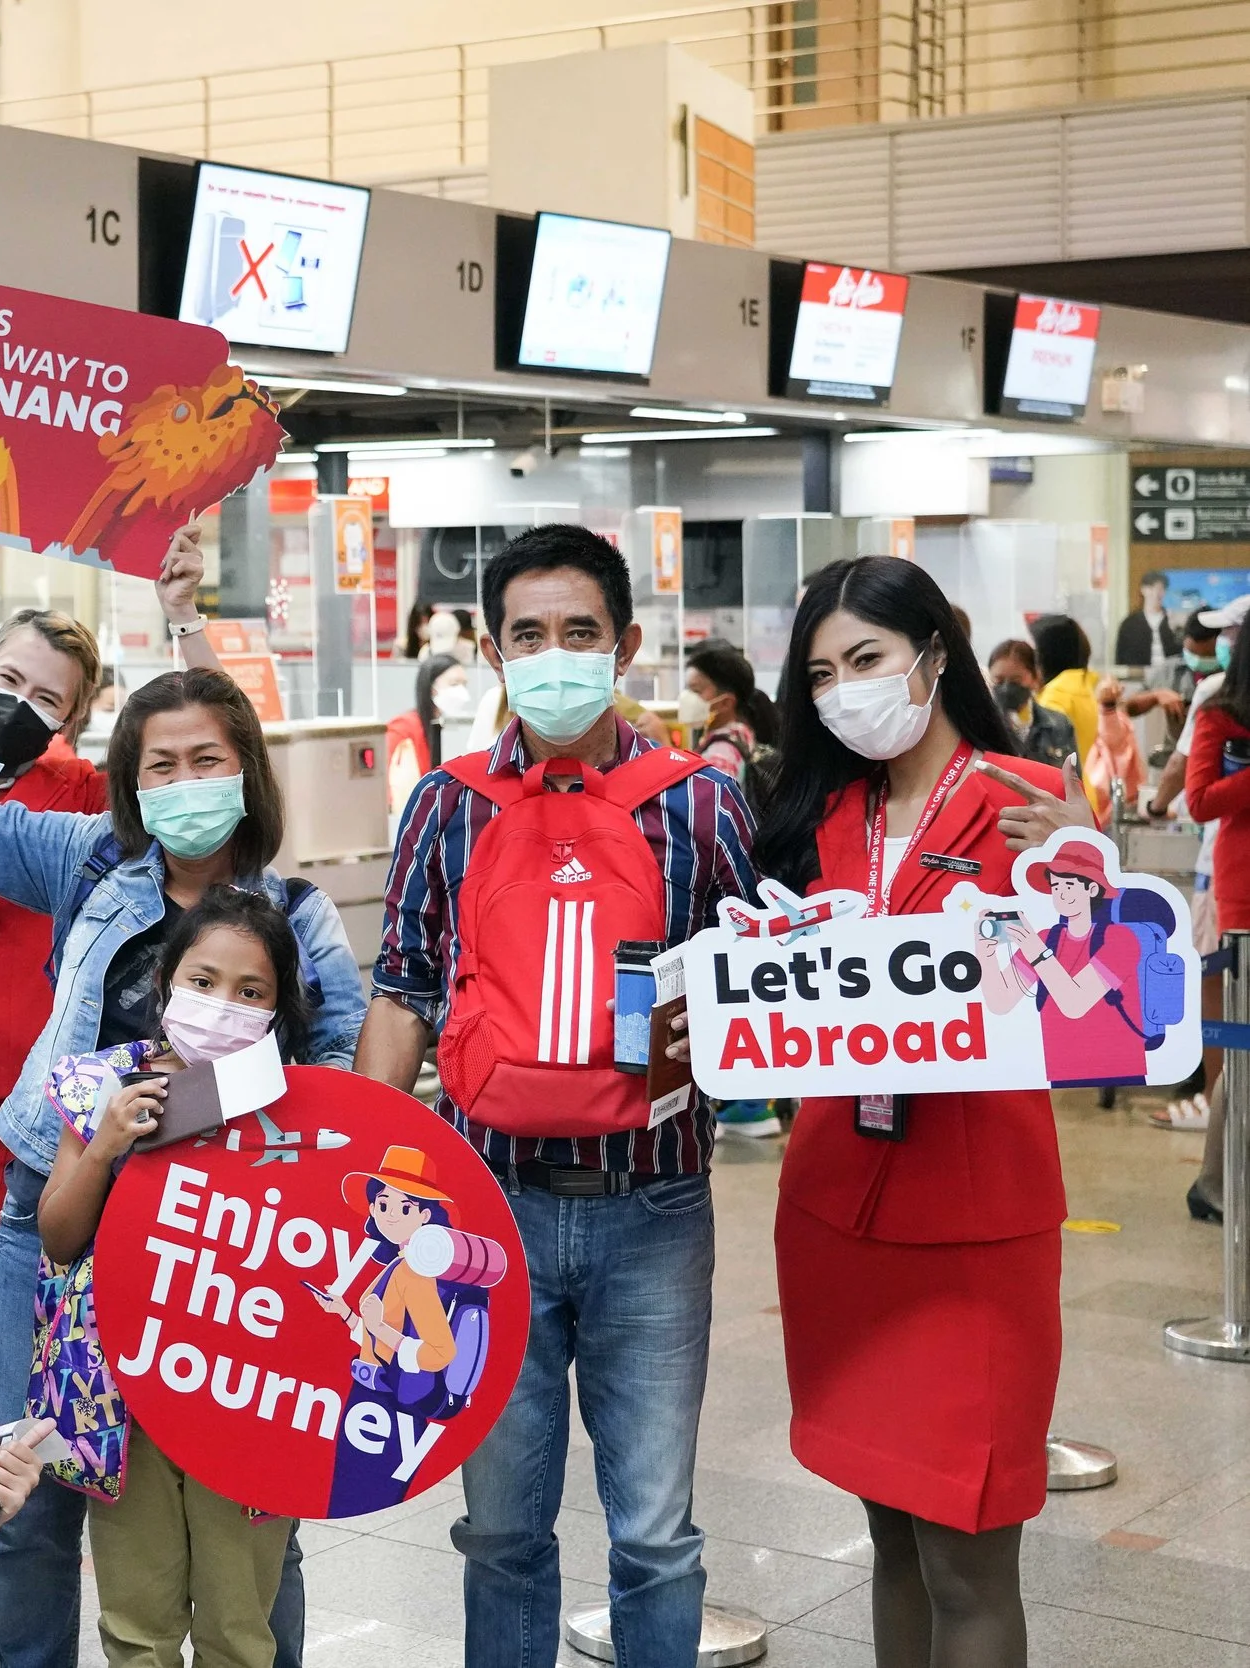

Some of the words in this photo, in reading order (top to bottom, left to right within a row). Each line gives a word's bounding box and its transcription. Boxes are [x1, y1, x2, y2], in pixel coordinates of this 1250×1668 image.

[86, 207, 120, 247] 1C
[456, 260, 484, 293] 1D
[739, 298, 760, 327] 1E
[960, 326, 976, 352] 1F
[84, 359, 129, 394] TO
[933, 785, 948, 803] ONE
[944, 768, 959, 786] FOR
[953, 754, 967, 769] ALL
[872, 828, 882, 845] FOR
[873, 813, 882, 828] ALL
[910, 827, 924, 846] FOR
[920, 809, 934, 828] ONE
[870, 846, 880, 865] ONE
[550, 871, 593, 884] adidas
[868, 869, 878, 887] ONE
[864, 907, 875, 919] AL
[866, 888, 877, 907] FOR
[713, 946, 872, 1004] Let's
[888, 940, 983, 996] Go
[718, 1001, 988, 1070] Abroad
[156, 1162, 381, 1294] Enjoy
[145, 1235, 285, 1339] The
[117, 1315, 447, 1483] Journey
